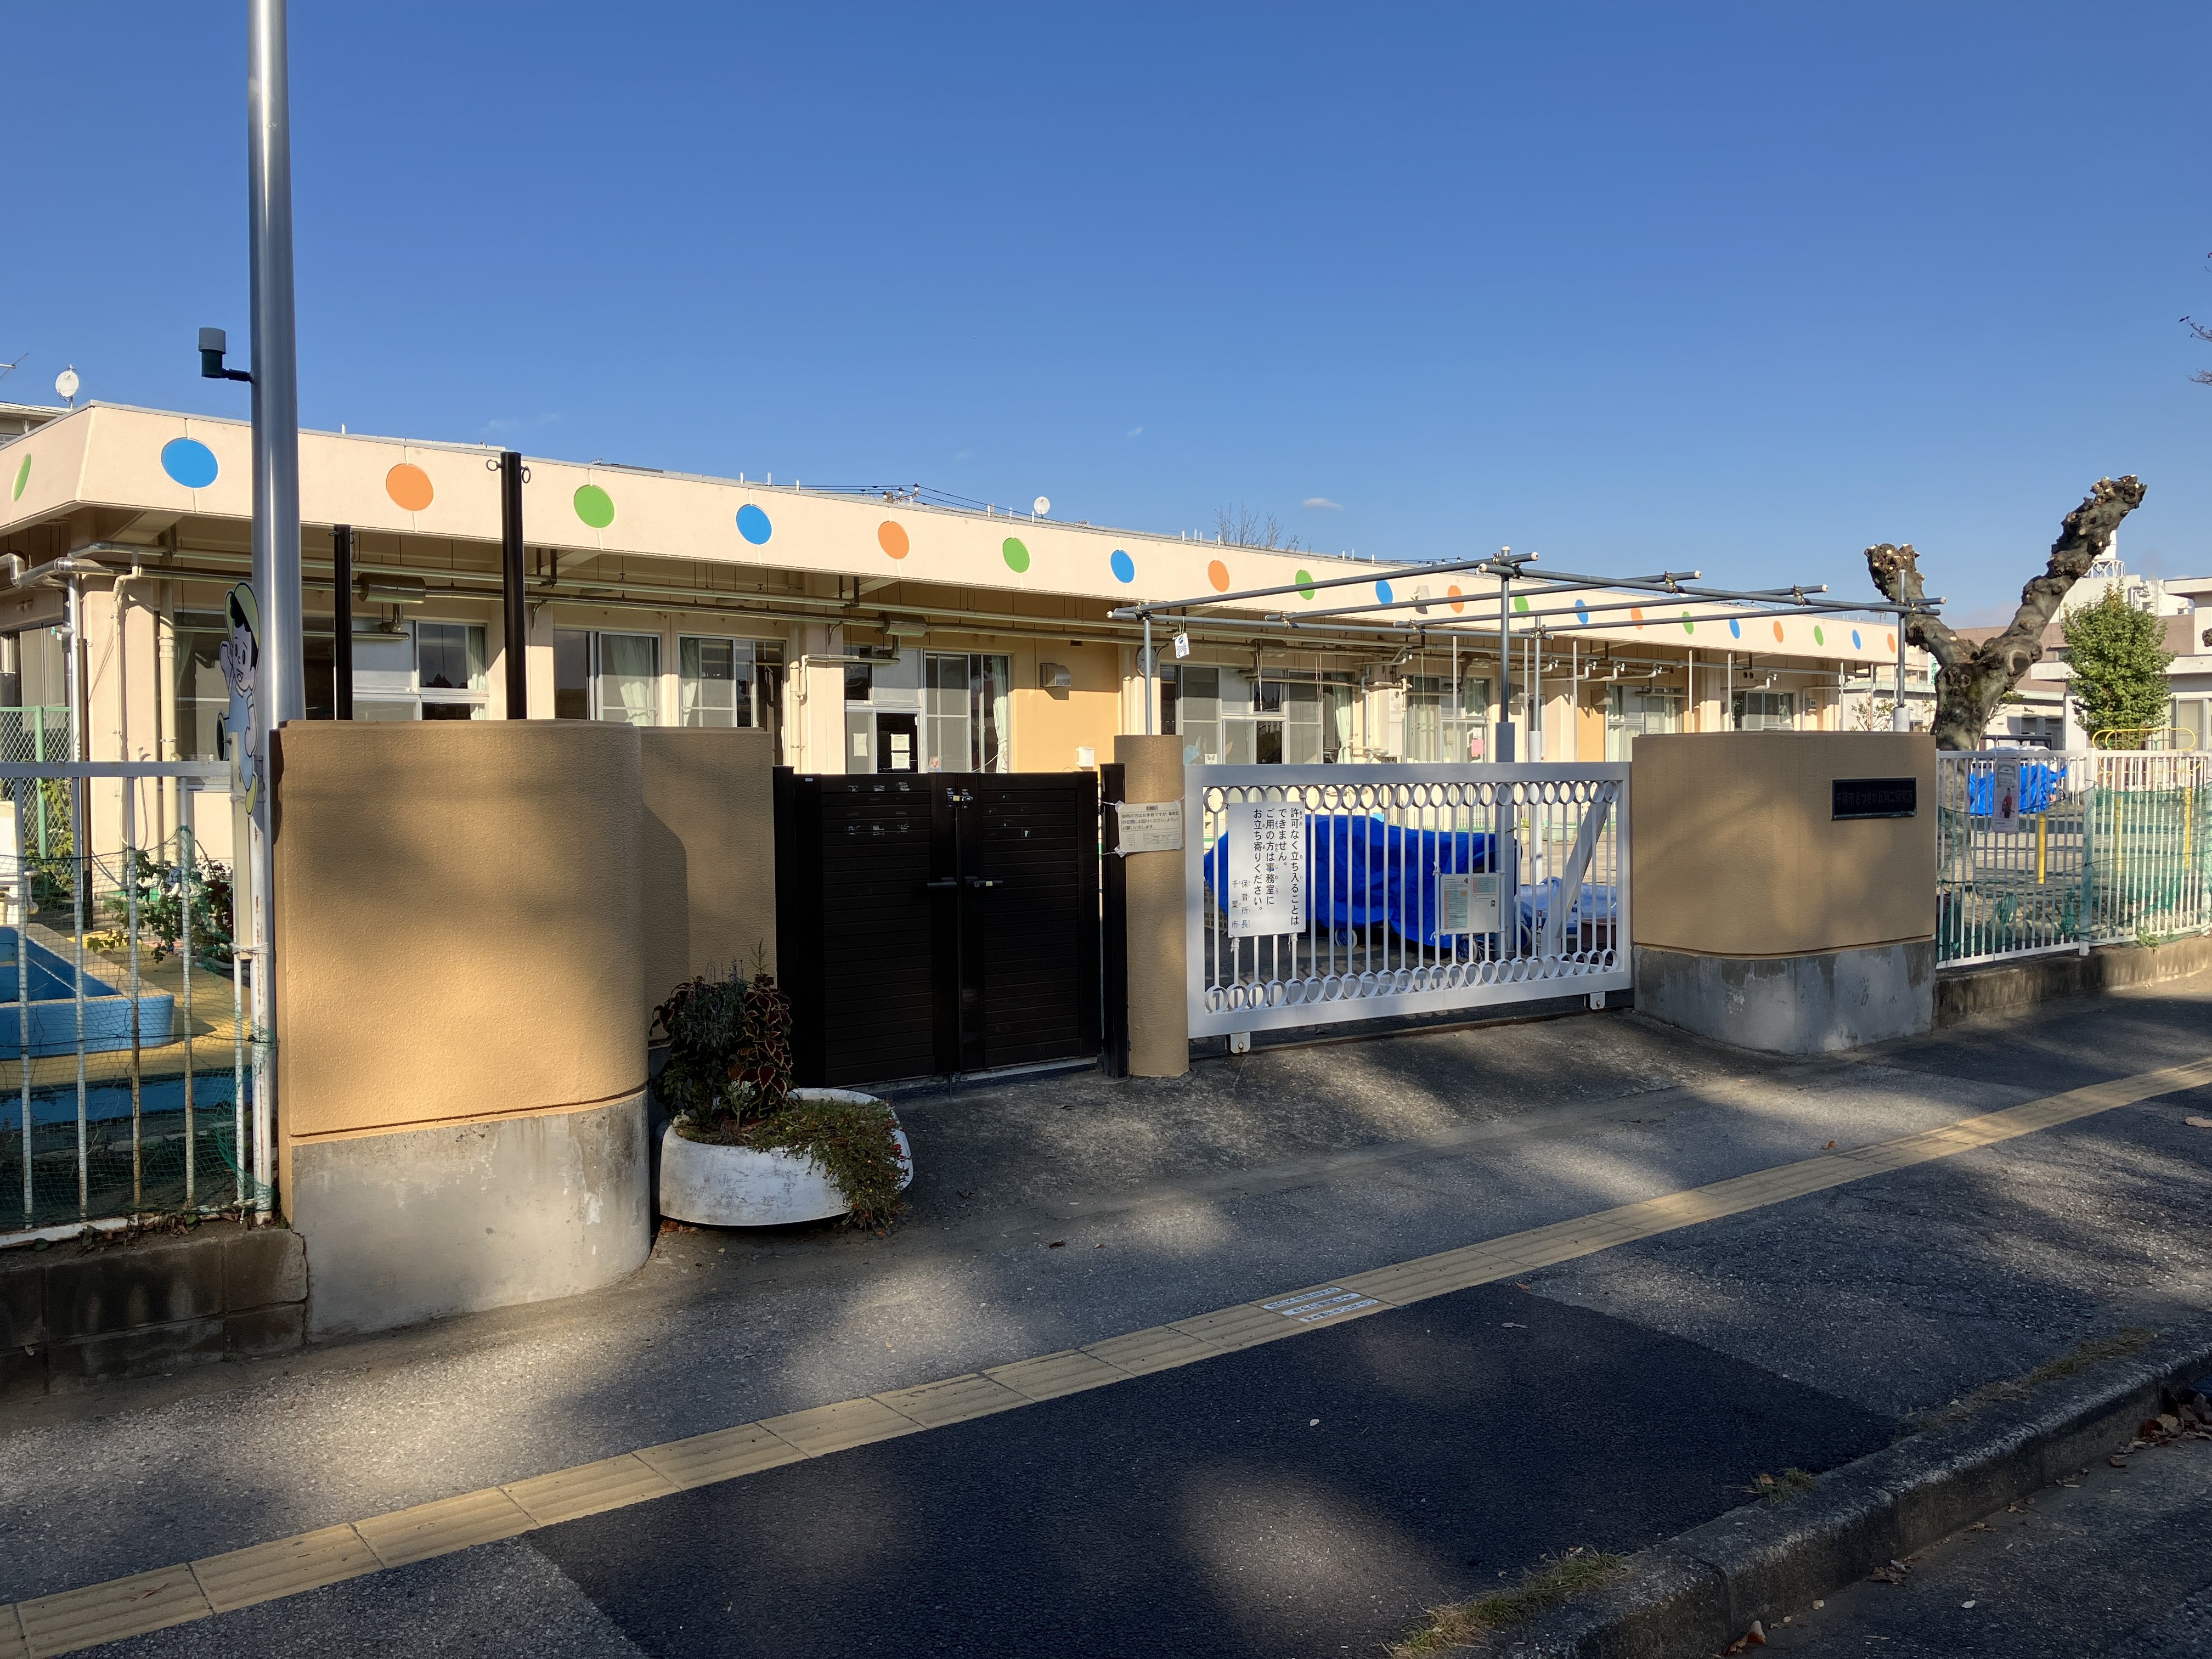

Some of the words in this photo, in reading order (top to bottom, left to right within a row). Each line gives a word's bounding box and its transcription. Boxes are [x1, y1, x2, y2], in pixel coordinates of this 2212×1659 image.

[1254, 809, 1262, 910] お立ち寄りください。
[1266, 808, 1275, 905] ご用の方は事務室に
[1278, 808, 1287, 866] できません。
[1290, 808, 1299, 925] 許可なく立ち入ることは
